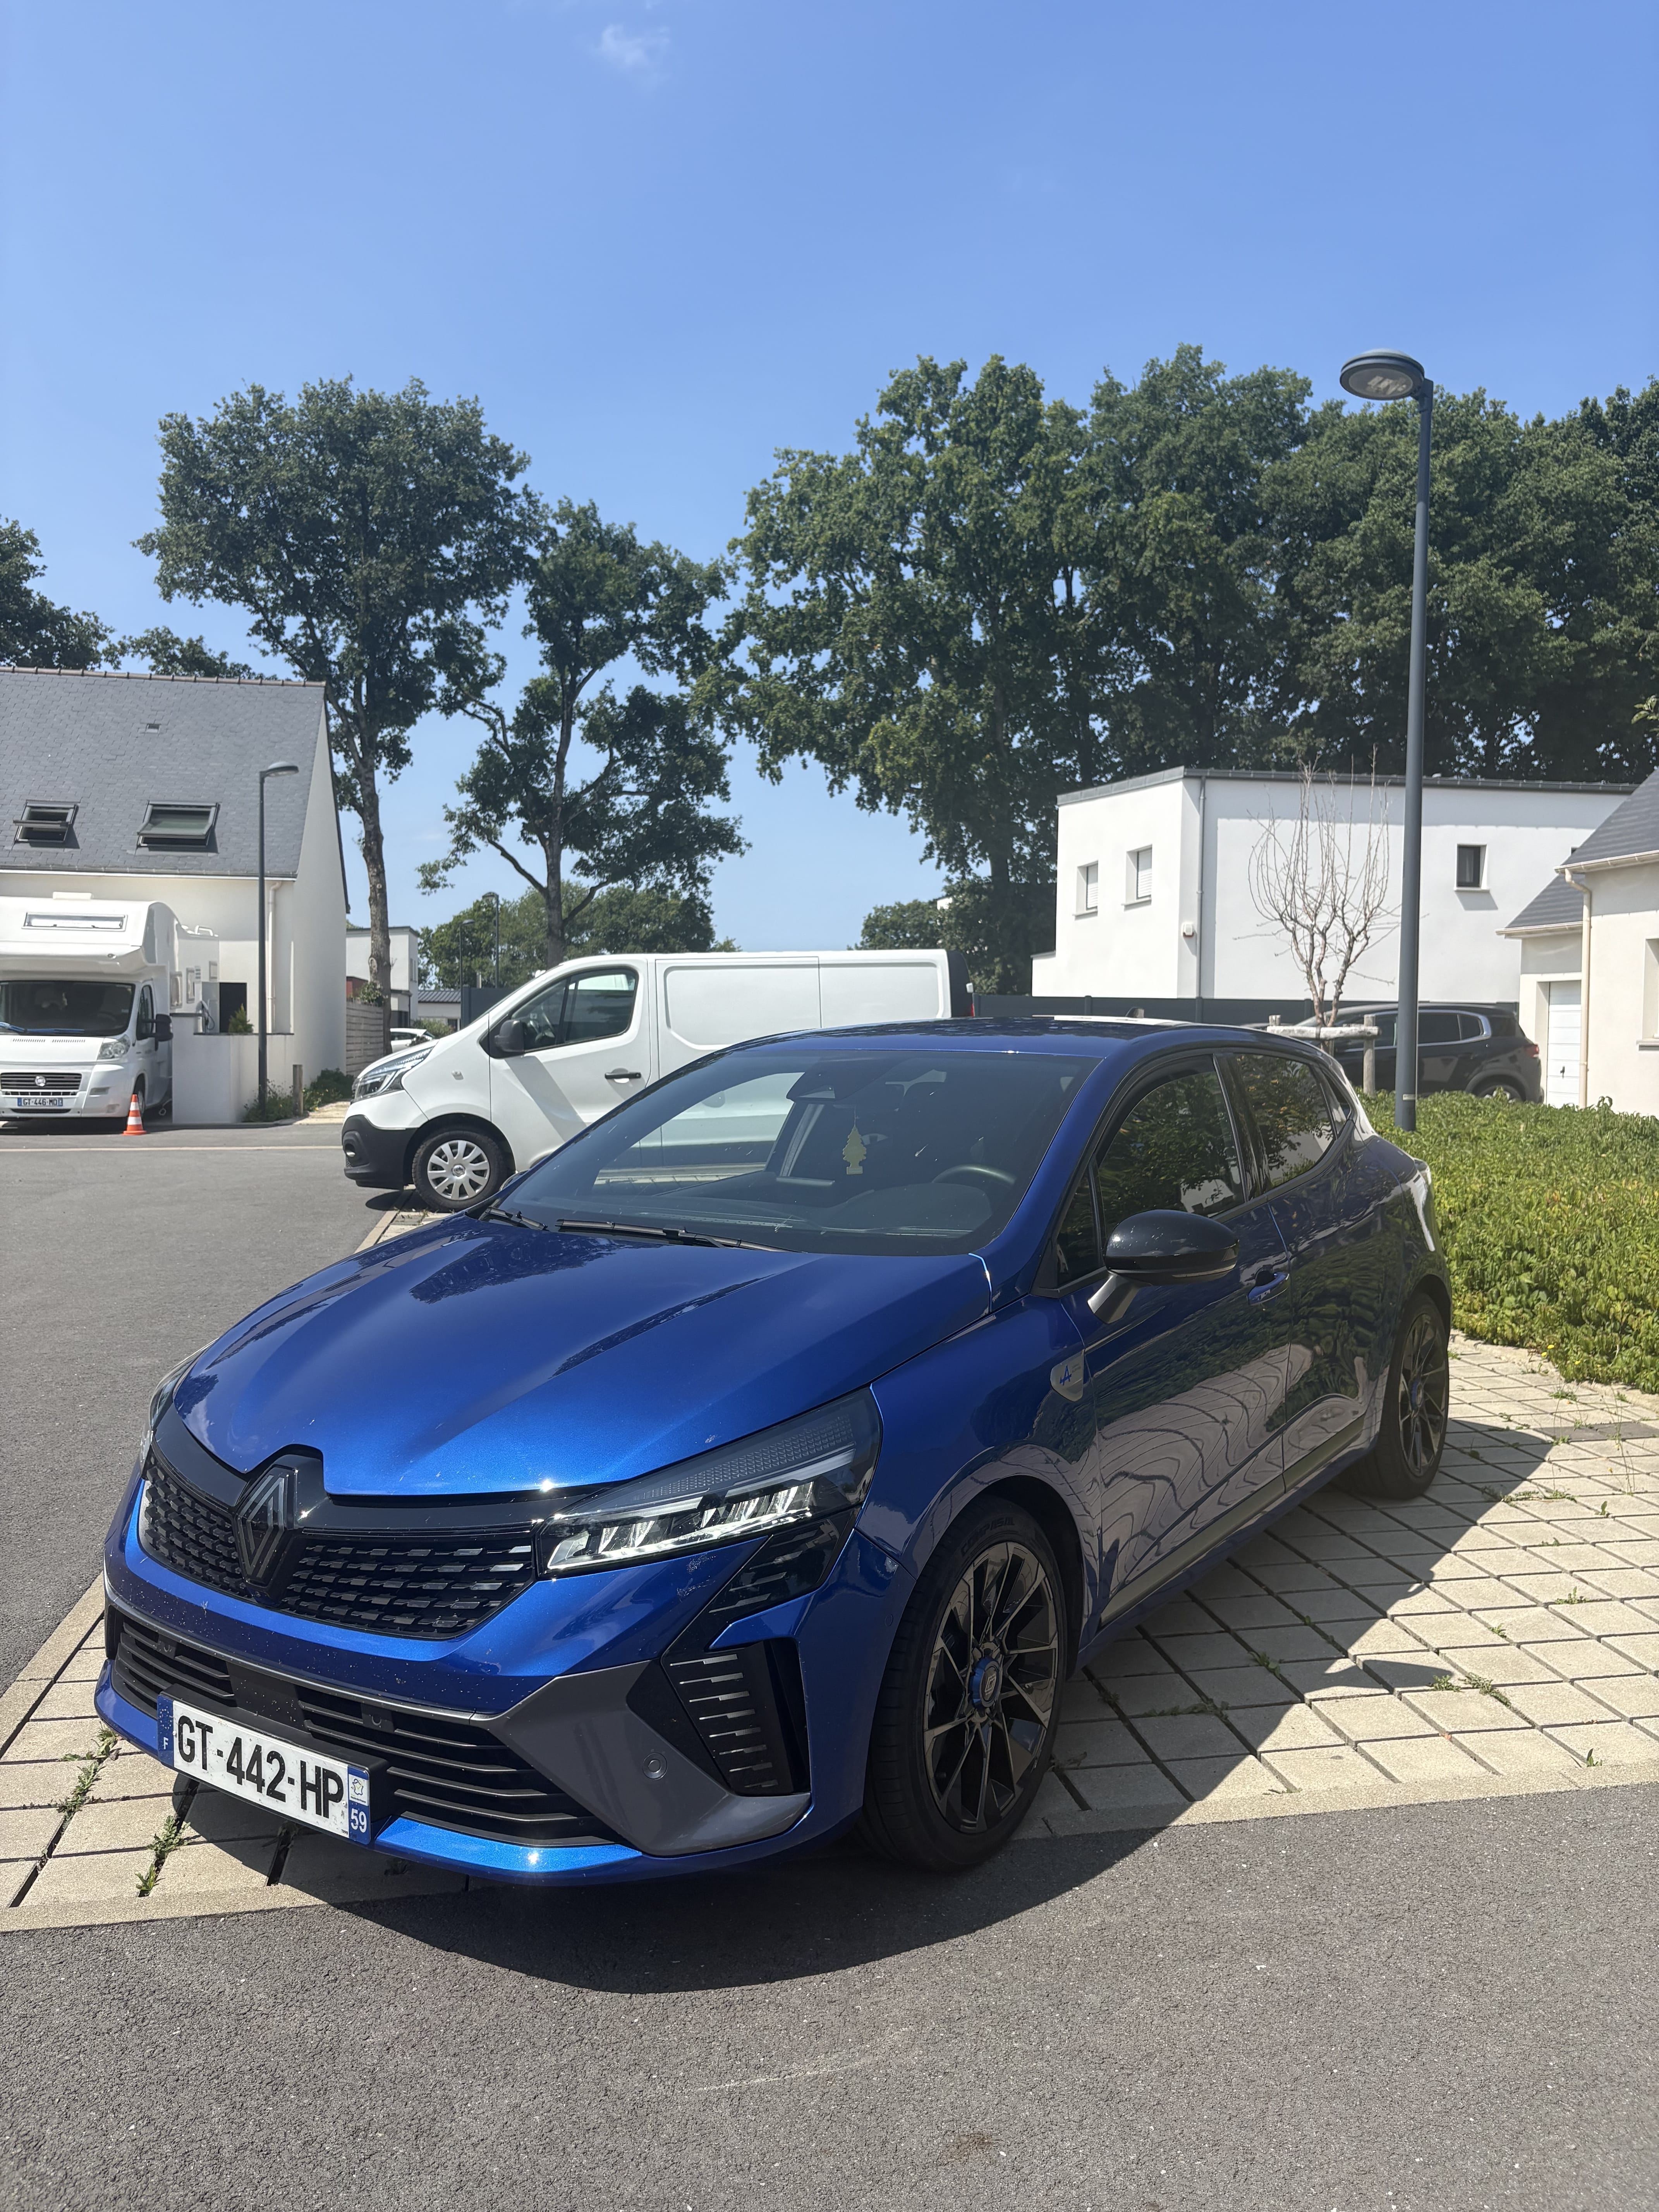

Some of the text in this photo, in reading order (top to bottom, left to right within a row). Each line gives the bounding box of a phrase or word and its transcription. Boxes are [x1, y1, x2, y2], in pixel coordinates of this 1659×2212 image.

[163, 1737, 168, 1750] F
[178, 1716, 344, 1819] GT-442-HP
[350, 1808, 368, 1833] 59
